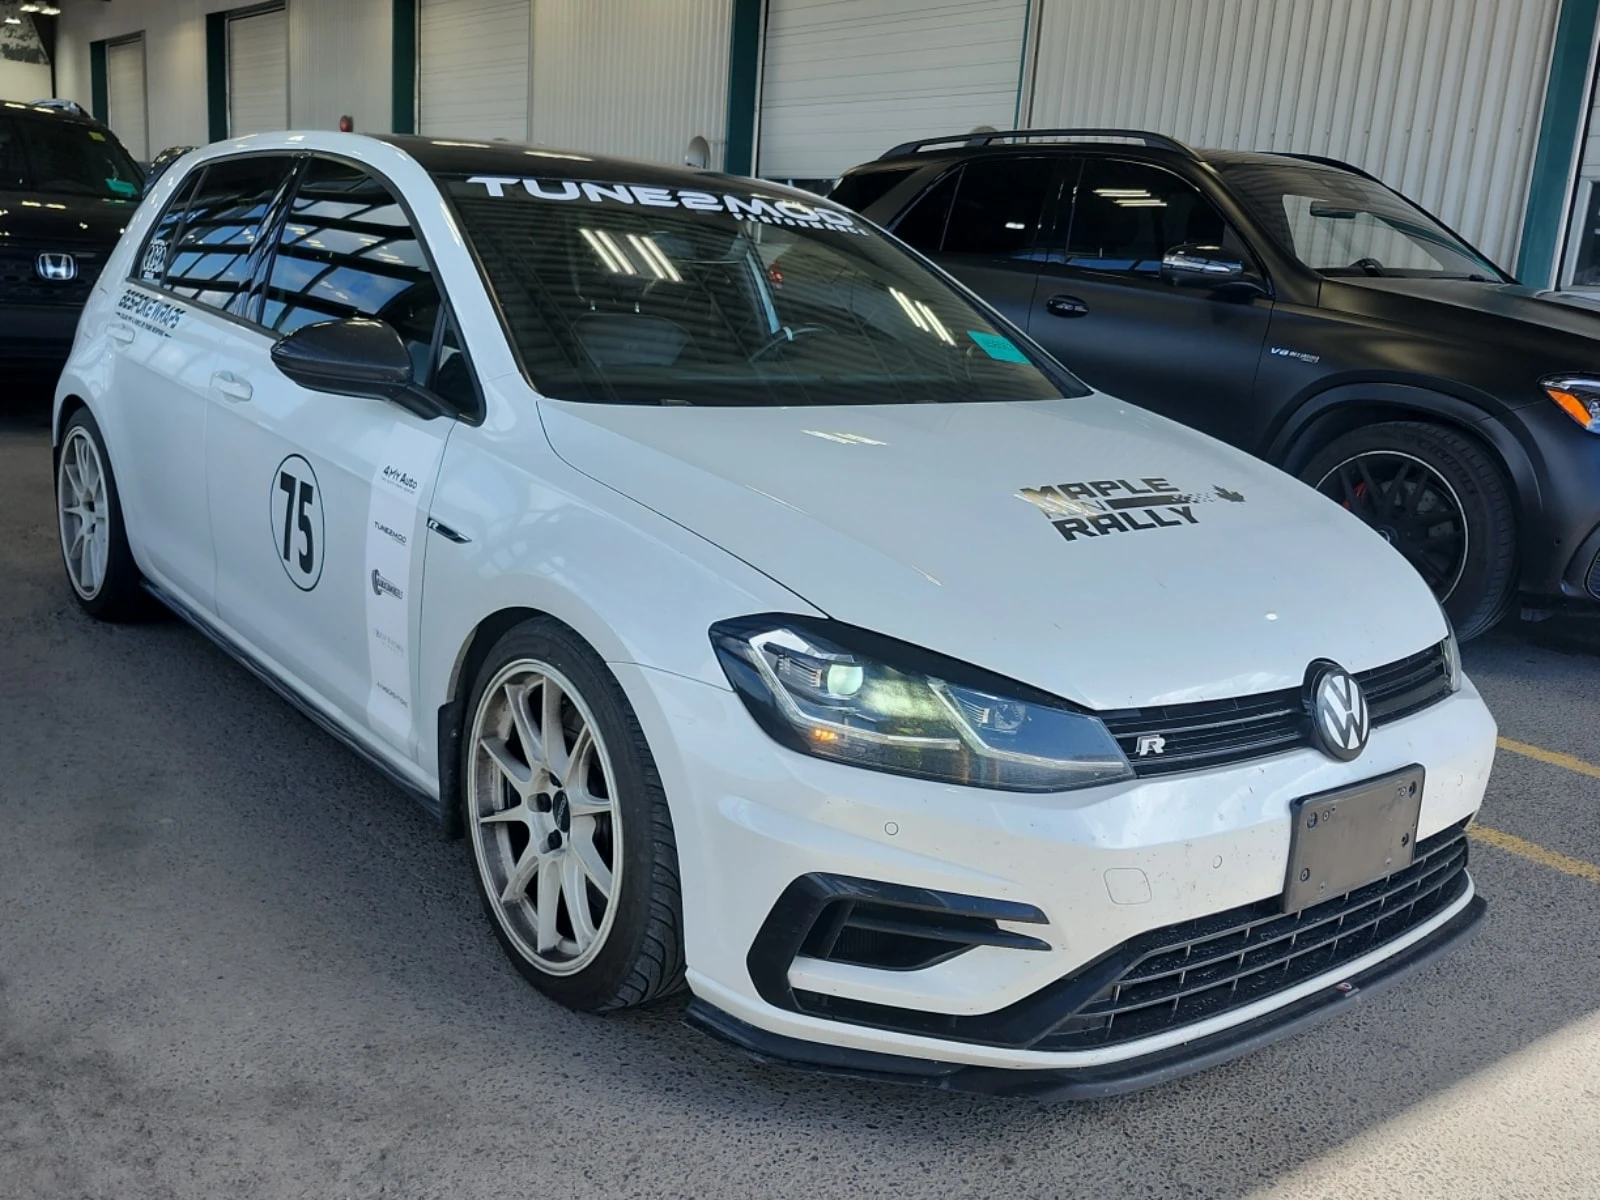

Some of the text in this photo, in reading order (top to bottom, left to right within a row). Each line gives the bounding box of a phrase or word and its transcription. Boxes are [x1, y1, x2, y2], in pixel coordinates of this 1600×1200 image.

[466, 176, 853, 226] TUNE2MOD
[1019, 477, 1181, 504] MAPLE
[280, 470, 314, 574] 75
[1051, 506, 1200, 541] RALLY
[1136, 734, 1166, 756] R
